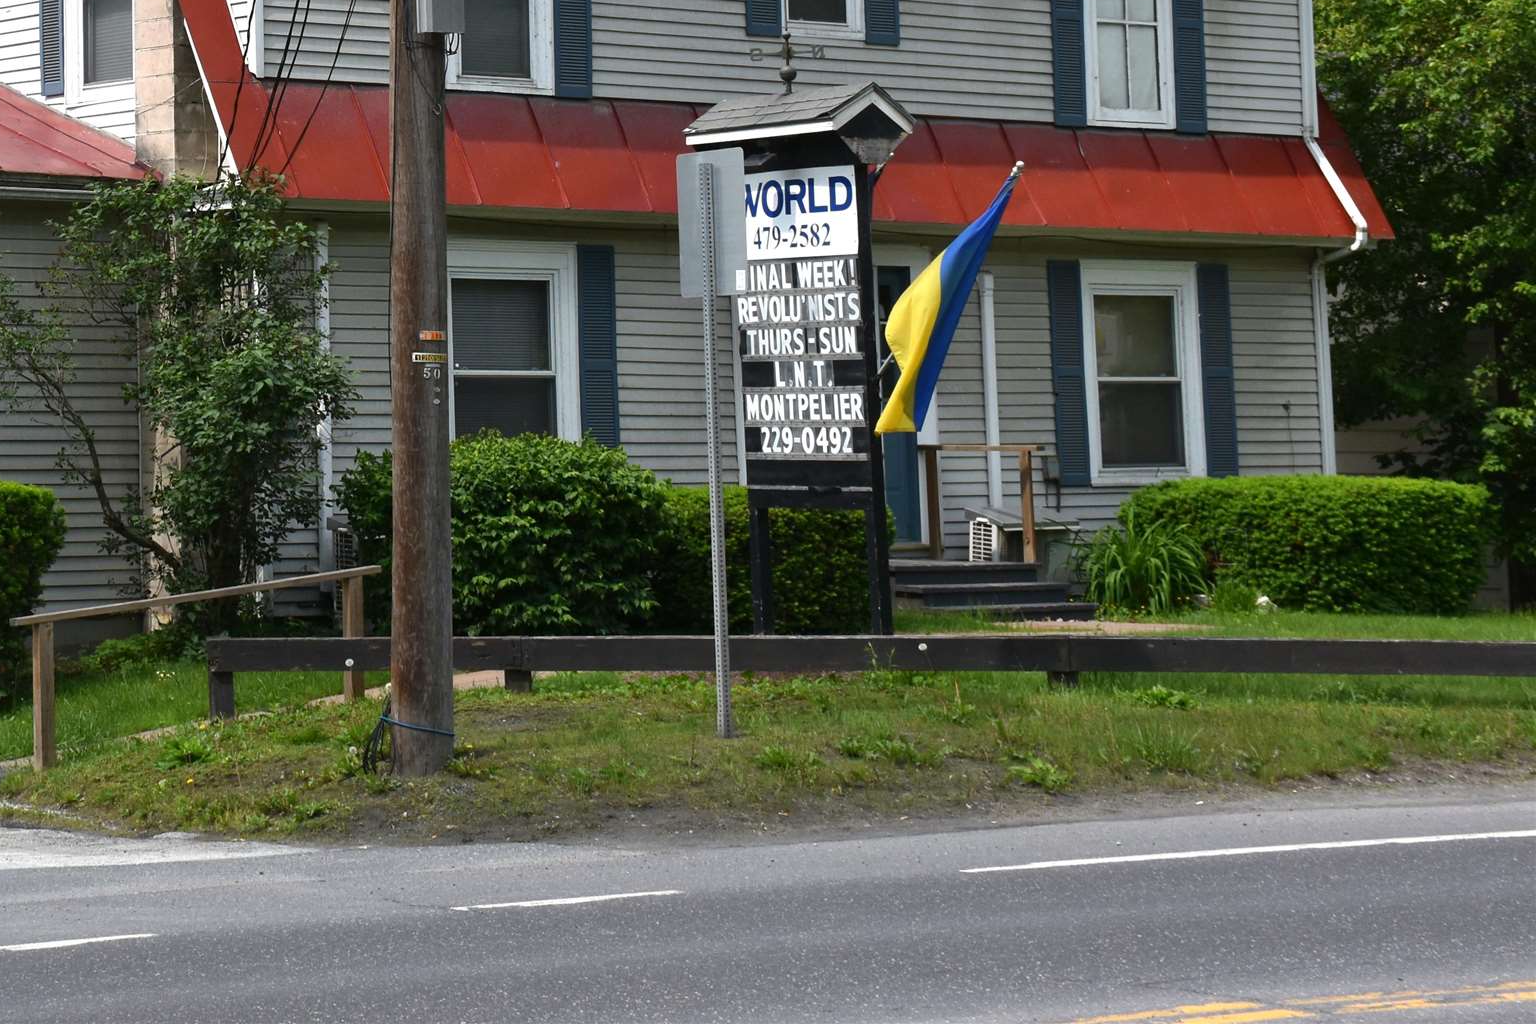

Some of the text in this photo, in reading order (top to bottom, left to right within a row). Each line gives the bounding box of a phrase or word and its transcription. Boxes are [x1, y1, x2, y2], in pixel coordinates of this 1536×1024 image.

[745, 176, 853, 218] WORLD
[754, 223, 831, 250] 479-2582
[750, 263, 792, 291] INAL
[737, 292, 861, 323] REVOLU'NISTS
[423, 367, 441, 380] 50
[745, 393, 864, 421] MONTPELIER
[760, 426, 854, 454] 229-0492
